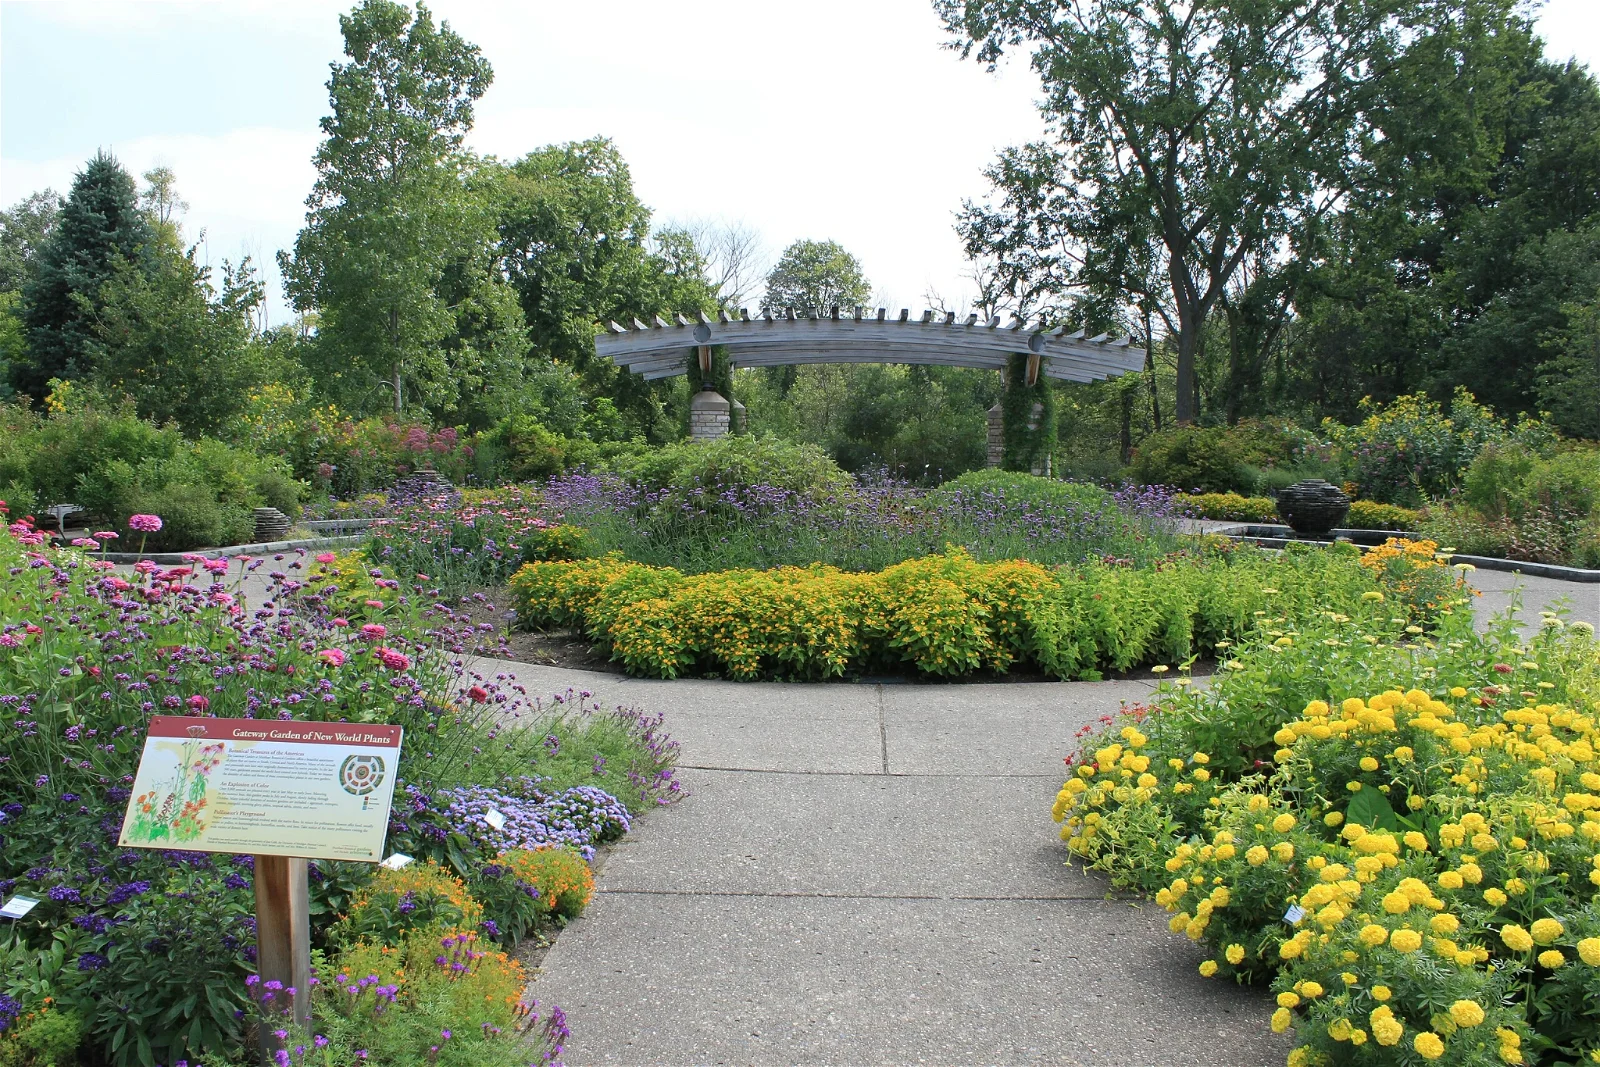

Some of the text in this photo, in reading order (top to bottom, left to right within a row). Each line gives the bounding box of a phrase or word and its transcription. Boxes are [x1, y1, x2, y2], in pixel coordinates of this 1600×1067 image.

[232, 728, 390, 744] Gateway Garden of New World Plants
